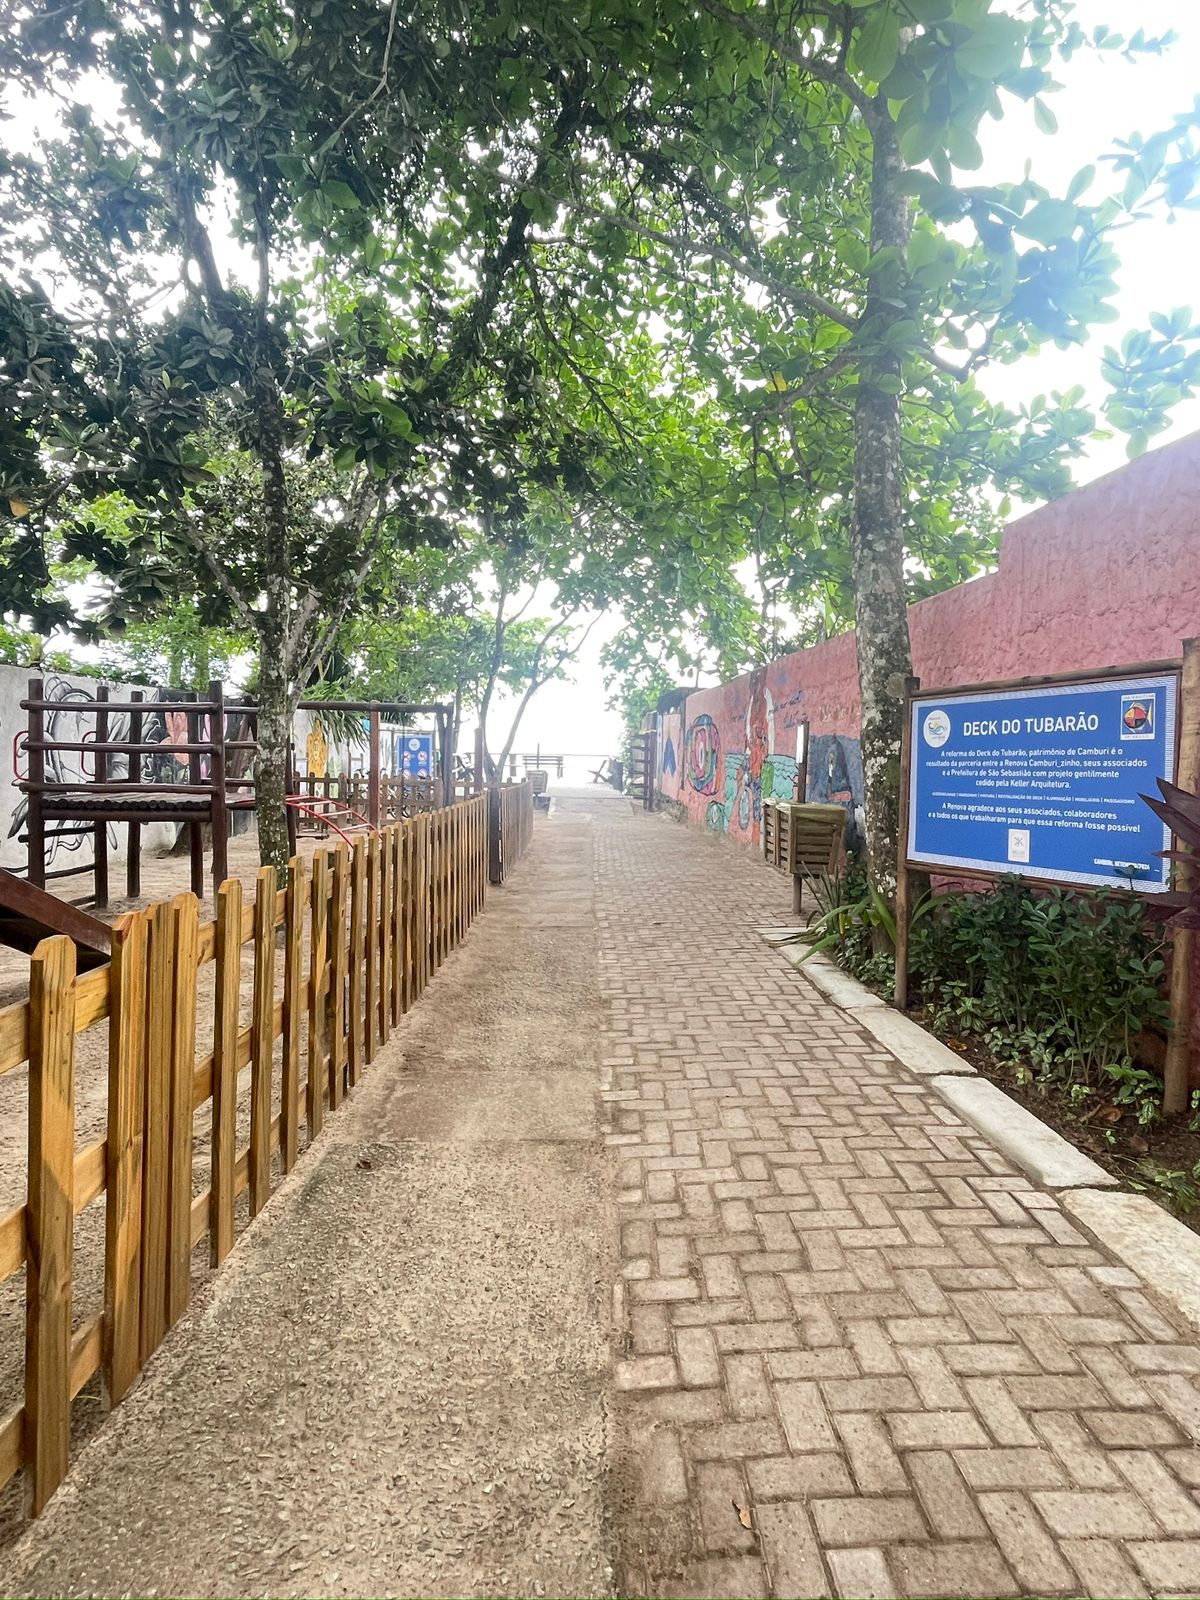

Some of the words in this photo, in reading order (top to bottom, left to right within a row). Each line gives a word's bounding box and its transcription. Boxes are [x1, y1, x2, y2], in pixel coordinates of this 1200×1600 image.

[964, 720, 997, 736] DECK
[1002, 719, 1021, 734] DO
[1025, 711, 1099, 733] TUBARÃO
[1028, 748, 1065, 756] patrimônio
[1078, 747, 1109, 755] Camburi
[1048, 770, 1072, 778] projeto
[1075, 770, 1119, 778] gentilmente
[1031, 781, 1071, 789] Arquitetura.
[968, 804, 994, 812] agradece
[1064, 811, 1117, 819] colaboradores
[970, 814, 1006, 822] trabalharam
[1085, 822, 1105, 830] fosse
[1108, 823, 1140, 832] possível
